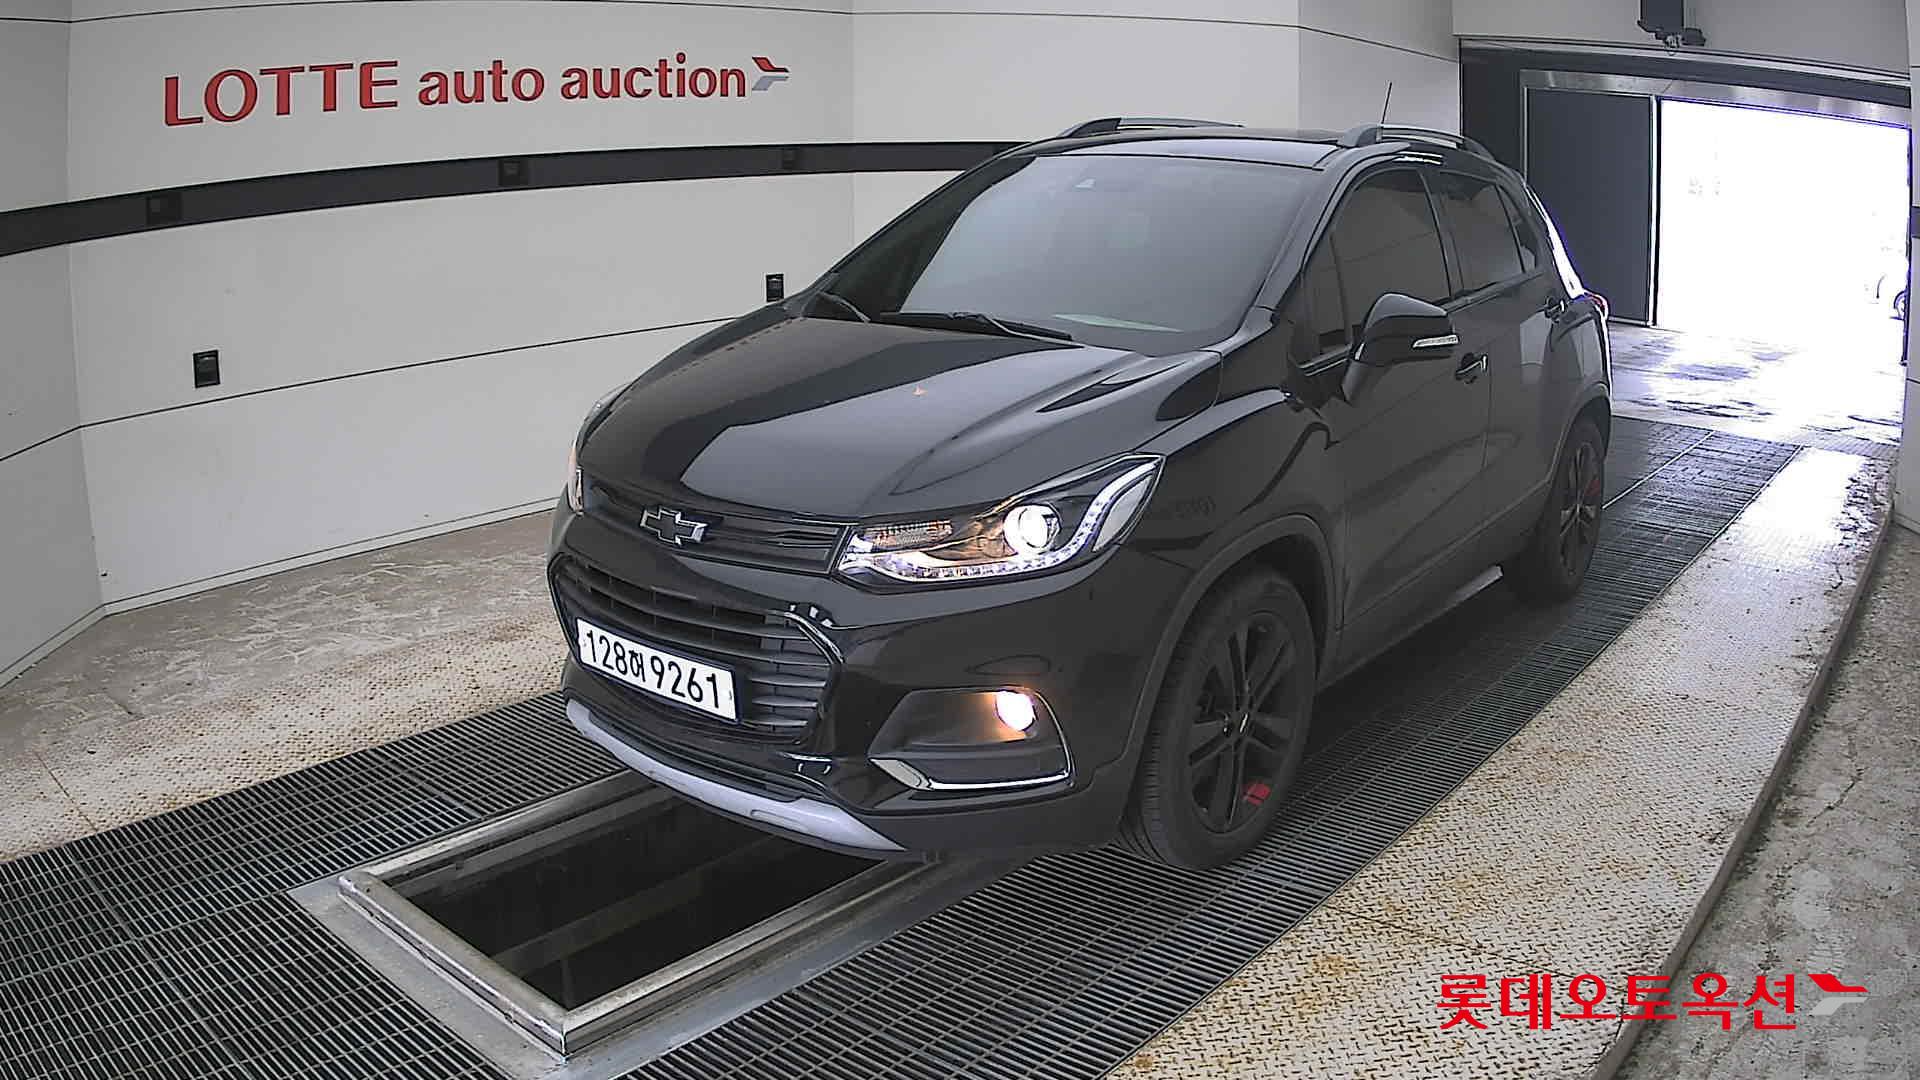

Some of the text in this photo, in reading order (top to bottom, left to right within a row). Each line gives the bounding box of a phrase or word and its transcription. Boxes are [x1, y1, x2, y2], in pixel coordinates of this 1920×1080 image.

[164, 52, 746, 126] LOTTE auto auction
[587, 630, 719, 709] 128허9261
